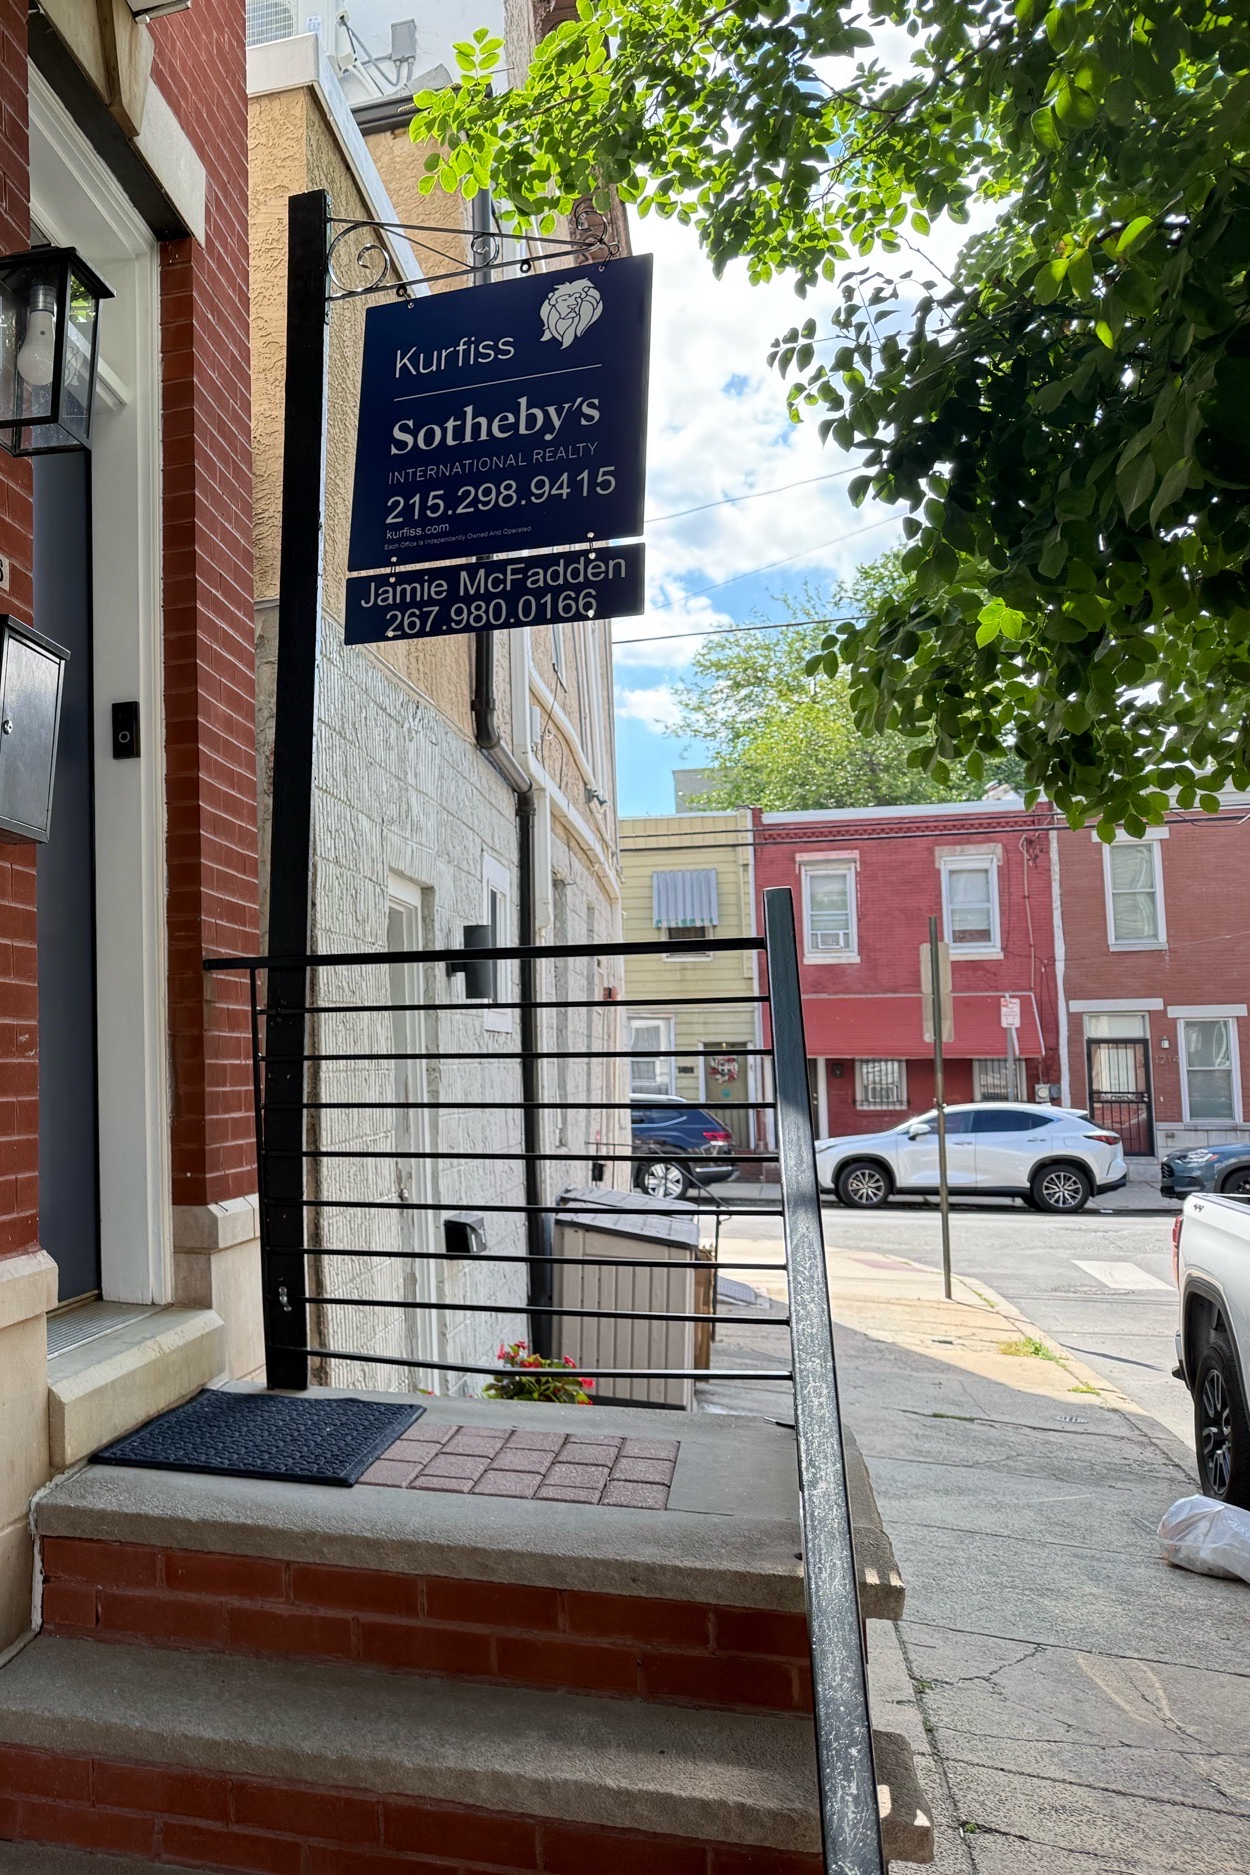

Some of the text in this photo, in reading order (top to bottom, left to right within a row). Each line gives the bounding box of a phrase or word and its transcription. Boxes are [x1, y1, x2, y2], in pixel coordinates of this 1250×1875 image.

[395, 336, 515, 378] Kurfiss
[390, 396, 601, 456] Sotheby's
[388, 441, 598, 485] INTERNATIONAL REALTY
[385, 466, 617, 524] 215.298.9415
[386, 523, 450, 540] kurfiss.com
[400, 539, 417, 549] Office
[425, 533, 466, 545] Independently
[467, 531, 489, 539] Owned
[489, 529, 502, 537] And
[360, 557, 626, 609] Jamie McFadden
[385, 588, 598, 637] 267.980.0166
[1155, 1055, 1179, 1065] 1214
